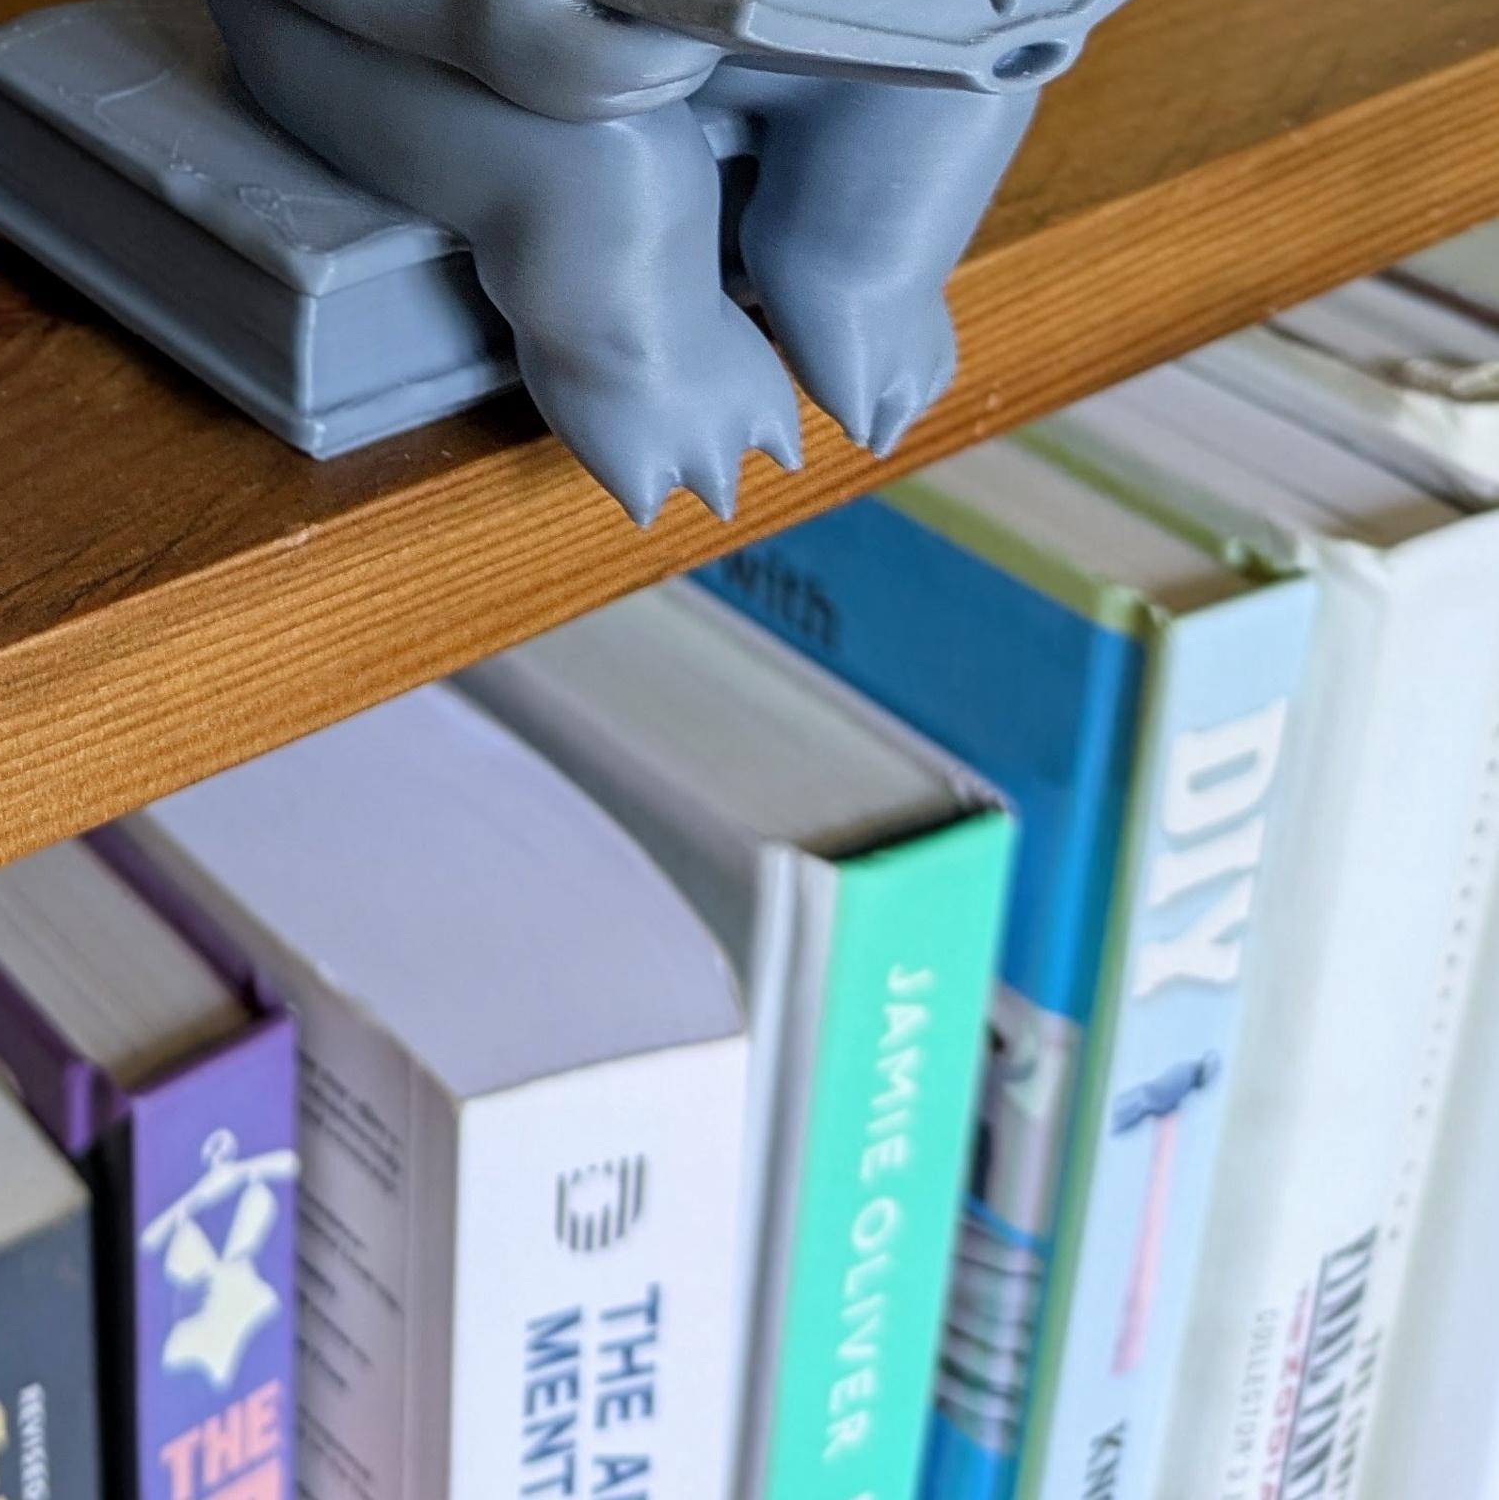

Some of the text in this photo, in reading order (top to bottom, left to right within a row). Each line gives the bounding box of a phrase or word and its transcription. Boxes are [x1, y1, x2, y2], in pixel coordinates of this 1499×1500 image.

[1130, 697, 1288, 1000] DIY
[822, 963, 933, 1462] JAMIE OLIVER
[159, 1377, 283, 1500] THE
[596, 1279, 660, 1429] THE
